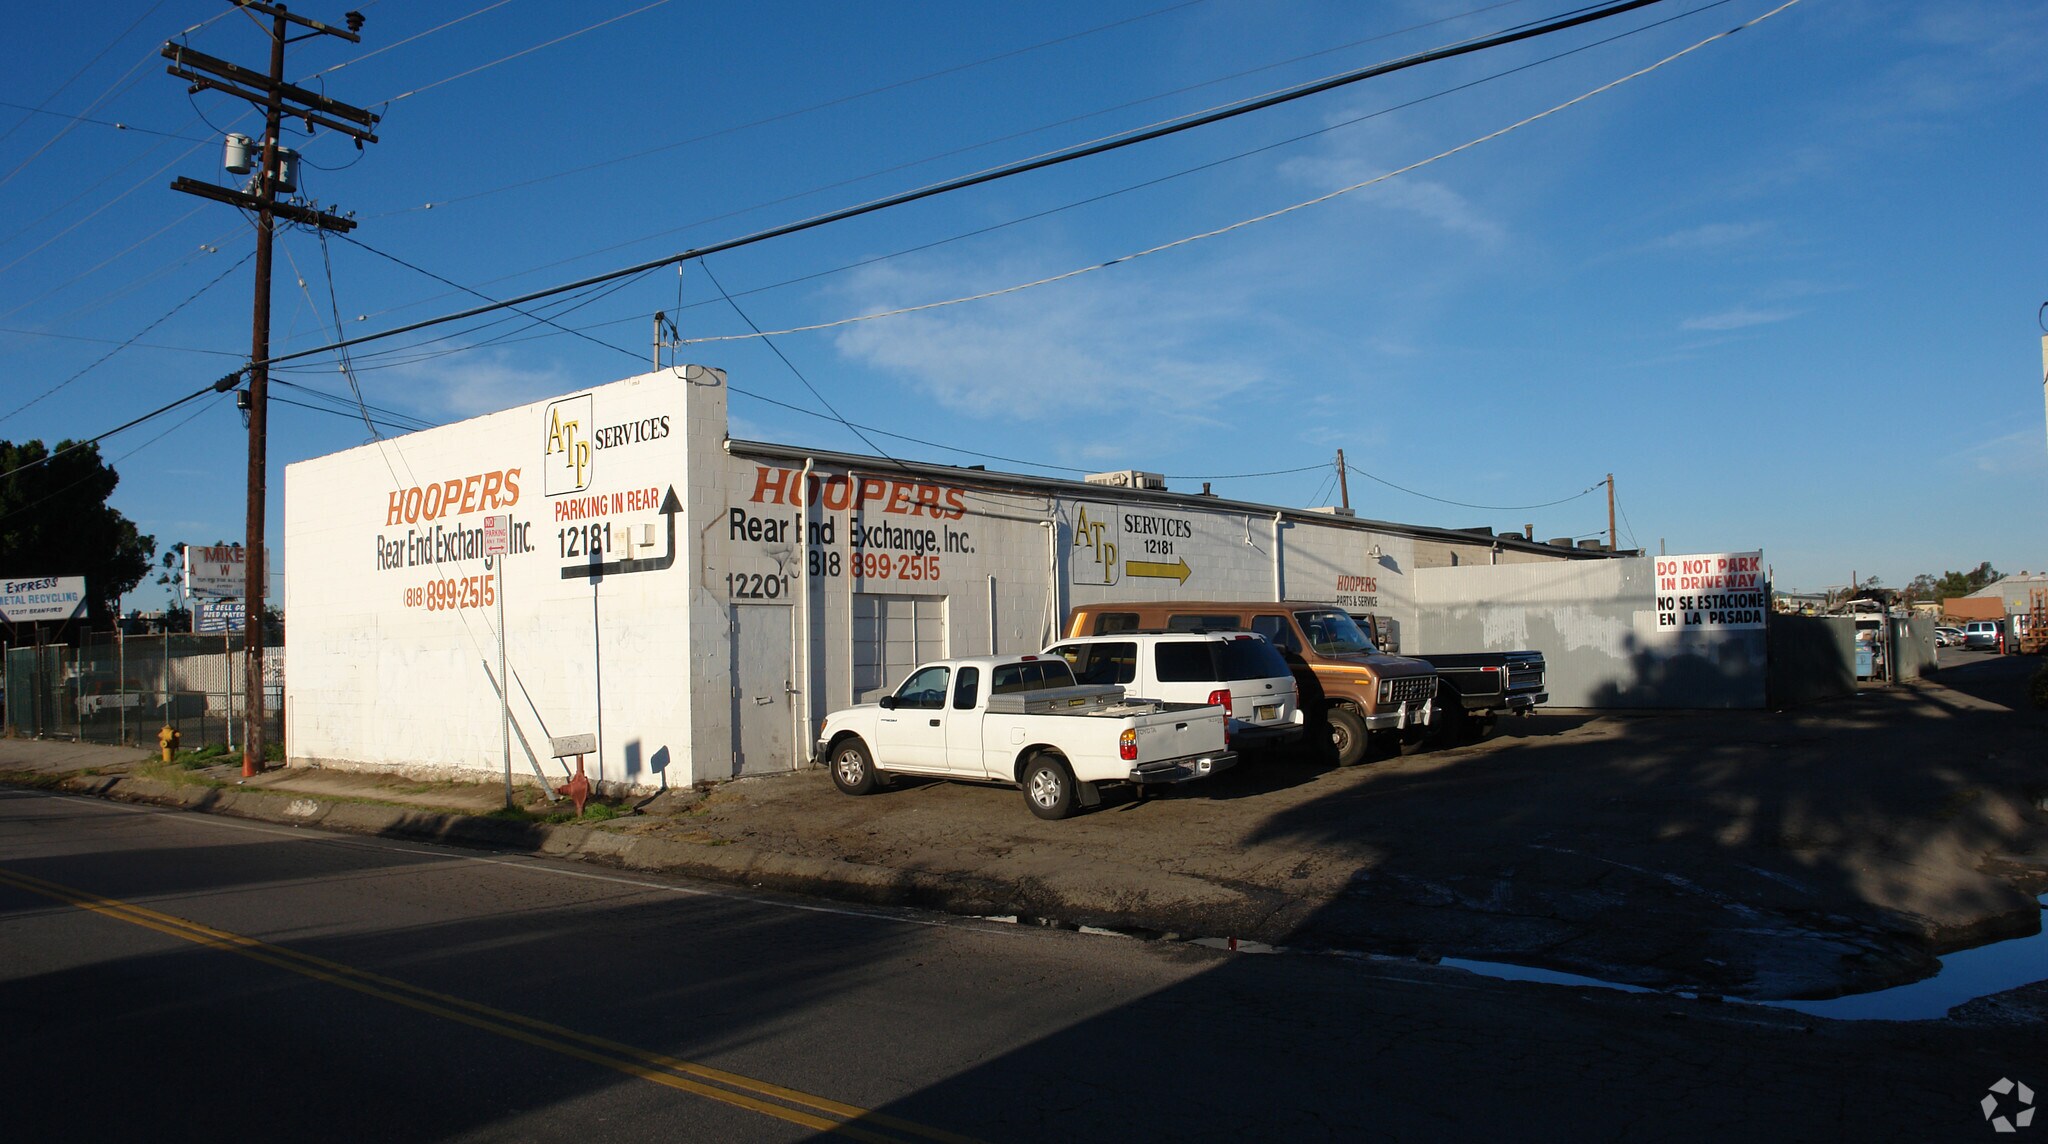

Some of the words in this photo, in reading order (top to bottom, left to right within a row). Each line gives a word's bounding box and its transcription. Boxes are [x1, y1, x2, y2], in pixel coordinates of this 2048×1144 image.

[595, 415, 670, 450] SERVICES
[385, 467, 521, 526] HOOPERS
[555, 495, 608, 522] PARKING
[611, 492, 623, 514] IN
[627, 487, 659, 511] REAR
[749, 467, 967, 521] HOOPERS
[486, 518, 494, 527] NO
[486, 529, 506, 537] PARKING
[730, 508, 788, 543] Rear
[850, 517, 940, 557] Exchange,
[944, 525, 975, 554] Inc.
[1124, 514, 1192, 539] SERVICES
[377, 534, 405, 571] Rear
[408, 526, 433, 567] End
[509, 513, 535, 555] Inc.
[558, 521, 611, 558] 12181
[1144, 539, 1174, 555] 12181
[809, 550, 841, 577] 818
[1657, 561, 1677, 576] DO
[1683, 559, 1711, 575] NOT
[1717, 556, 1760, 572] PARK
[5, 576, 59, 594] EXPRESS
[725, 573, 789, 598] 12201
[1336, 575, 1377, 593] HOOPERS
[1661, 577, 1676, 590] IN
[1681, 573, 1757, 590] DRIVEWAY
[28, 592, 78, 604] RECYCLING
[403, 586, 426, 608] (818)
[1336, 595, 1352, 606] PARTS
[1353, 596, 1358, 607] &
[1358, 595, 1378, 607] SERVICE
[1657, 596, 1675, 611] NO
[1680, 595, 1693, 610] SE
[1697, 593, 1765, 610] ESTACIONE
[1660, 613, 1676, 626] EN
[1684, 612, 1702, 625] LA
[1709, 610, 1762, 625] PASADA
